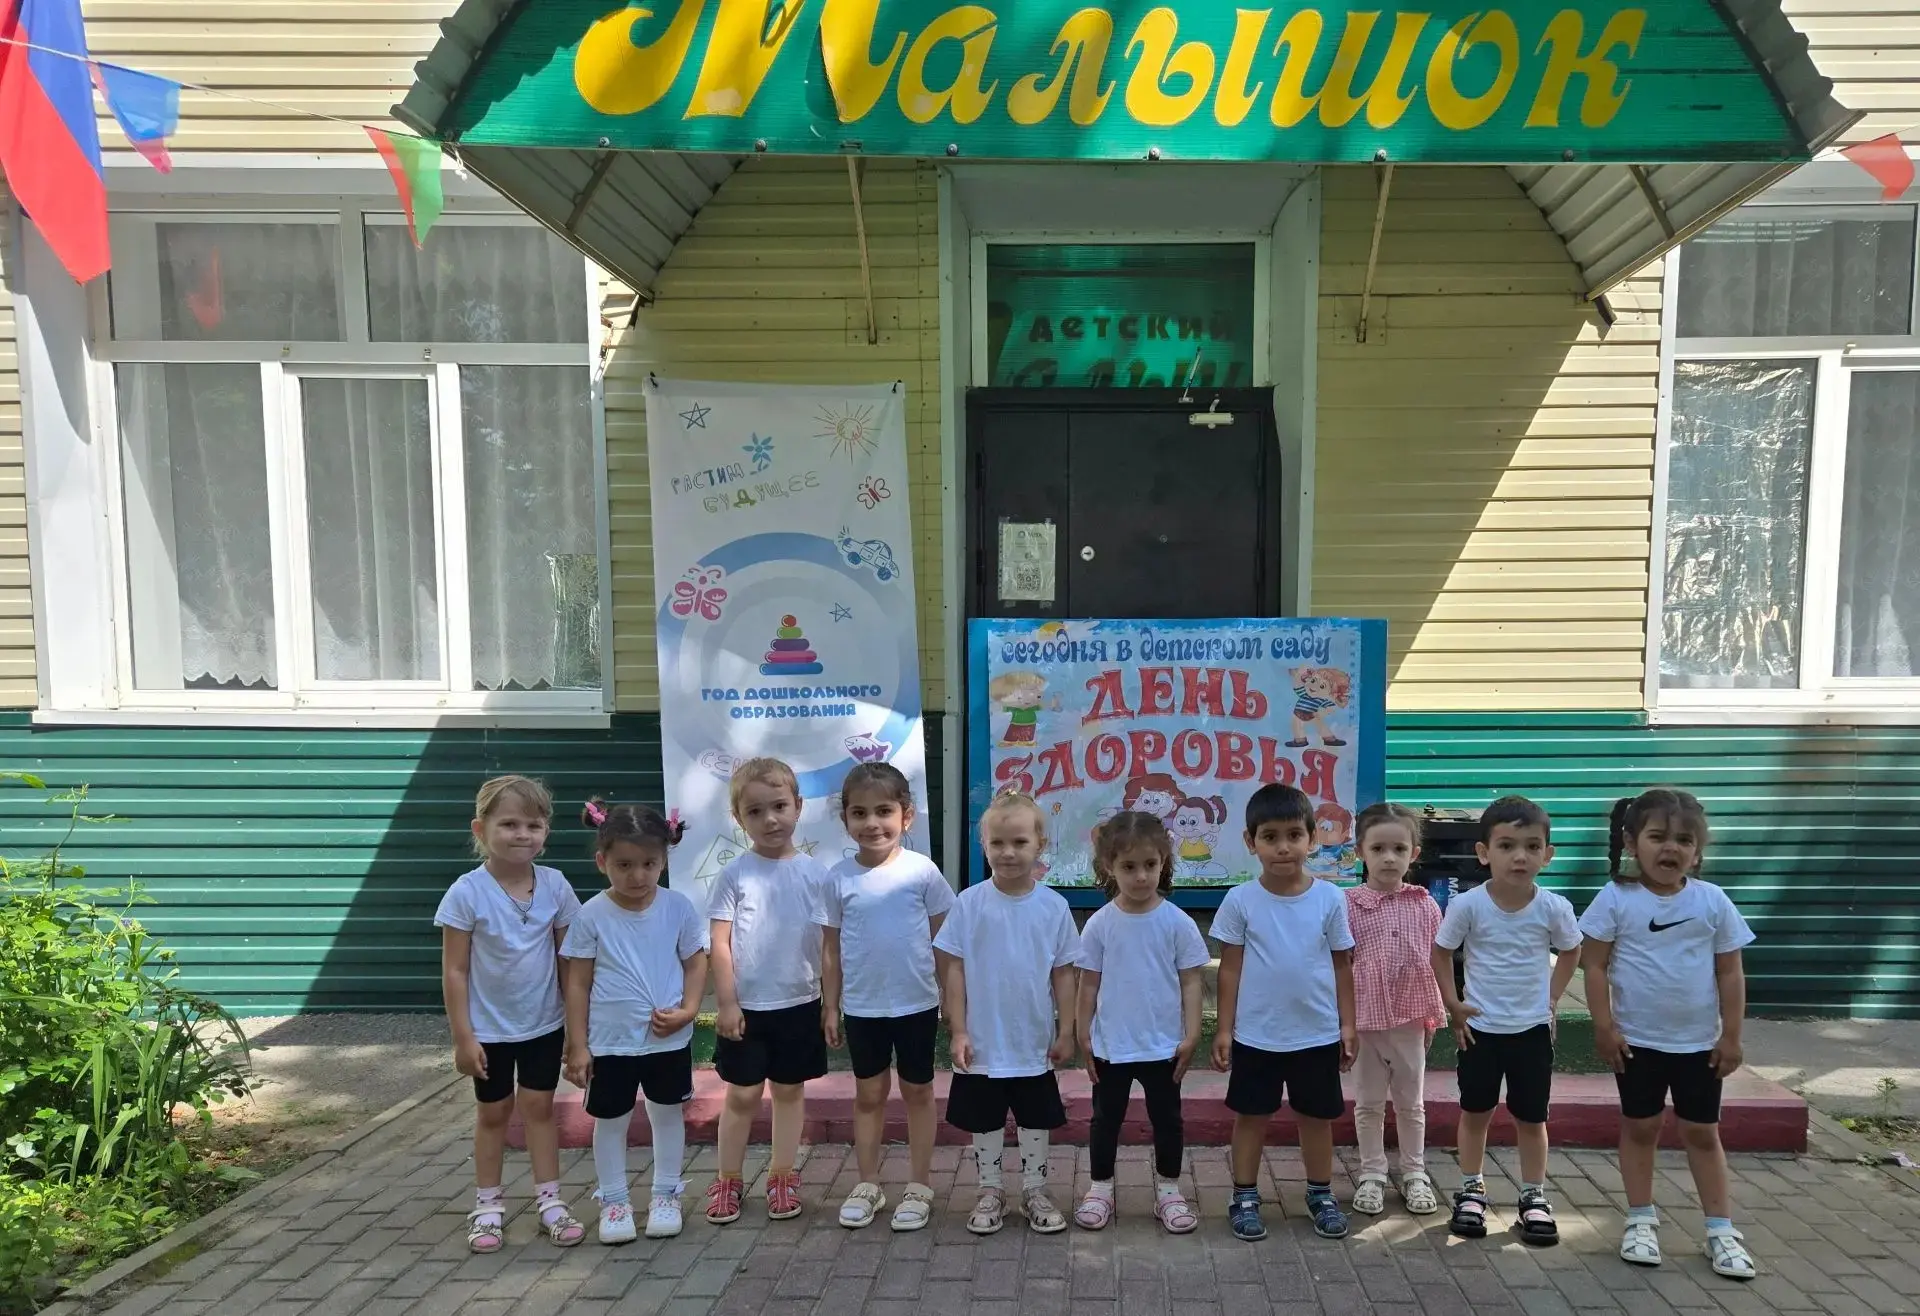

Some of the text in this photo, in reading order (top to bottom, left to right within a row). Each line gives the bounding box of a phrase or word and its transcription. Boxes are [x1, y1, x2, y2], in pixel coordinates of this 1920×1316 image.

[670, 462, 745, 495] РАСТИМ
[703, 470, 820, 513] БУДУЩЕЕ
[1001, 625, 1332, 665] сегодня в детском саду
[703, 686, 880, 700] ГОД ДОШКОЛЬНОГО
[730, 704, 856, 718] ОБРАЗОВАНИЯ
[1081, 666, 1268, 727] ДЕНЬ
[994, 728, 1340, 804] ЗДОРОВЬЯ
